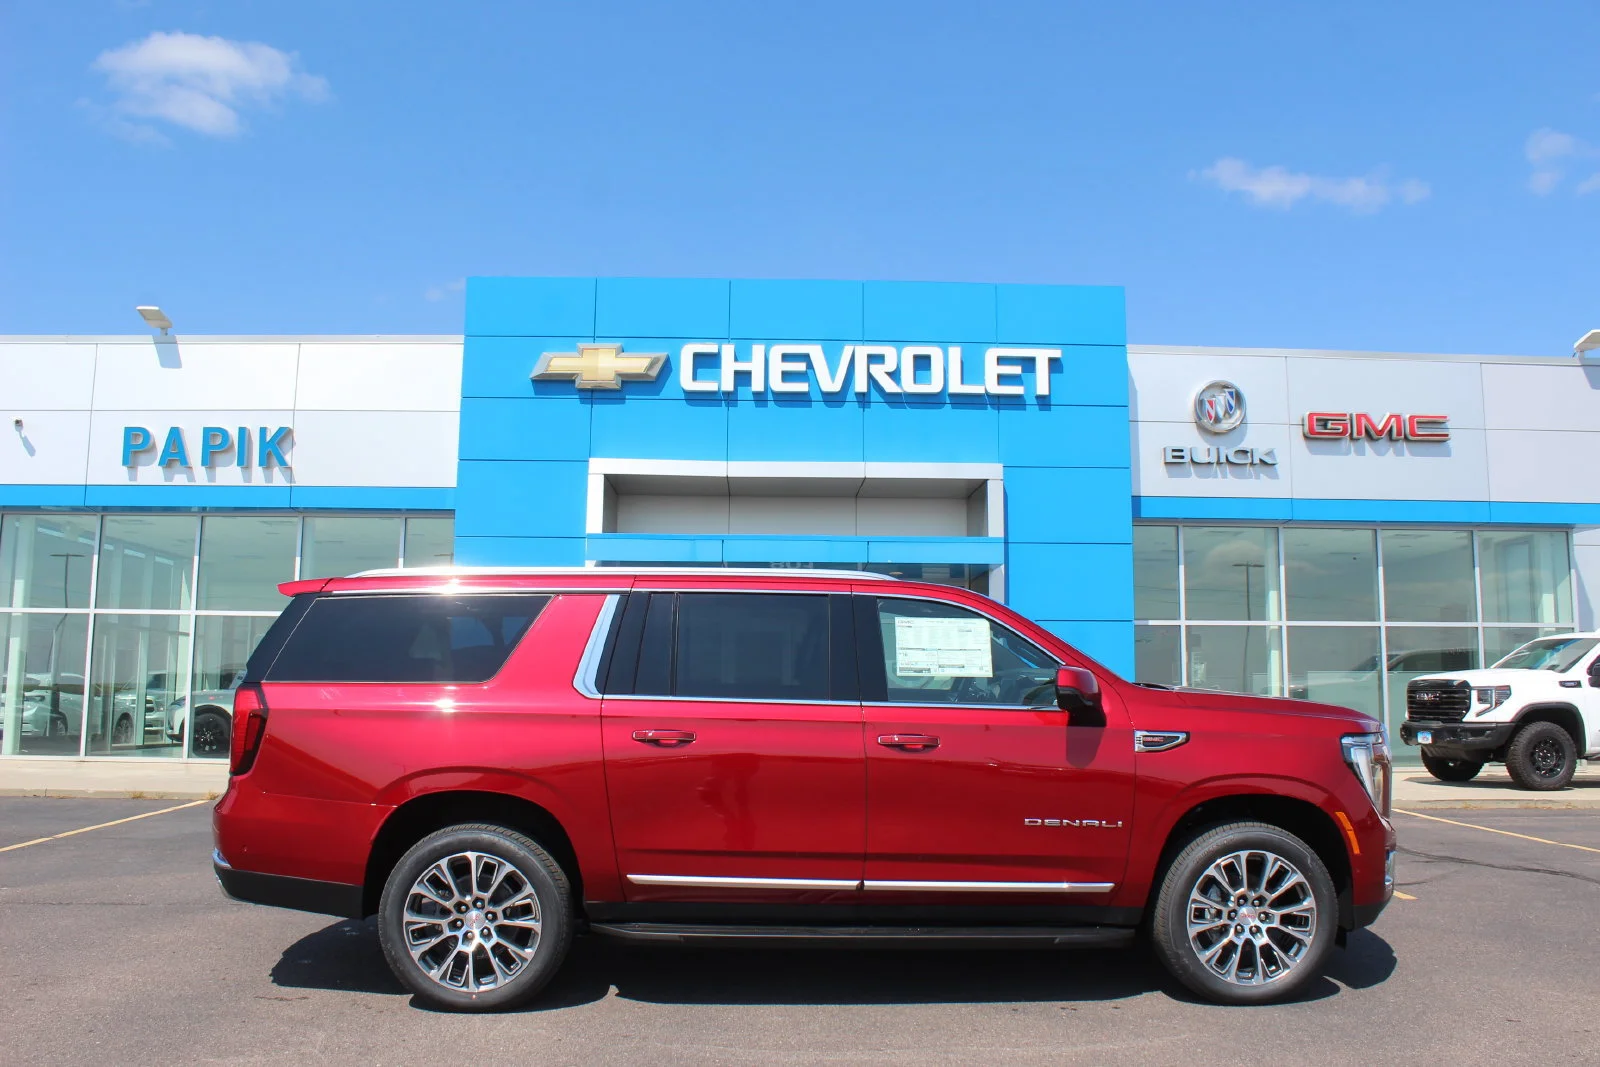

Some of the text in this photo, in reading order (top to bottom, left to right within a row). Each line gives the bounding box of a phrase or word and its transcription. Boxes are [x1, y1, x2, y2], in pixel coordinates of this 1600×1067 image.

[680, 343, 1062, 396] CHEVROLET
[1303, 411, 1452, 442] GMC
[122, 426, 292, 468] PAPIK
[1163, 445, 1278, 466] BUICK
[1024, 818, 1123, 828] DENALI
